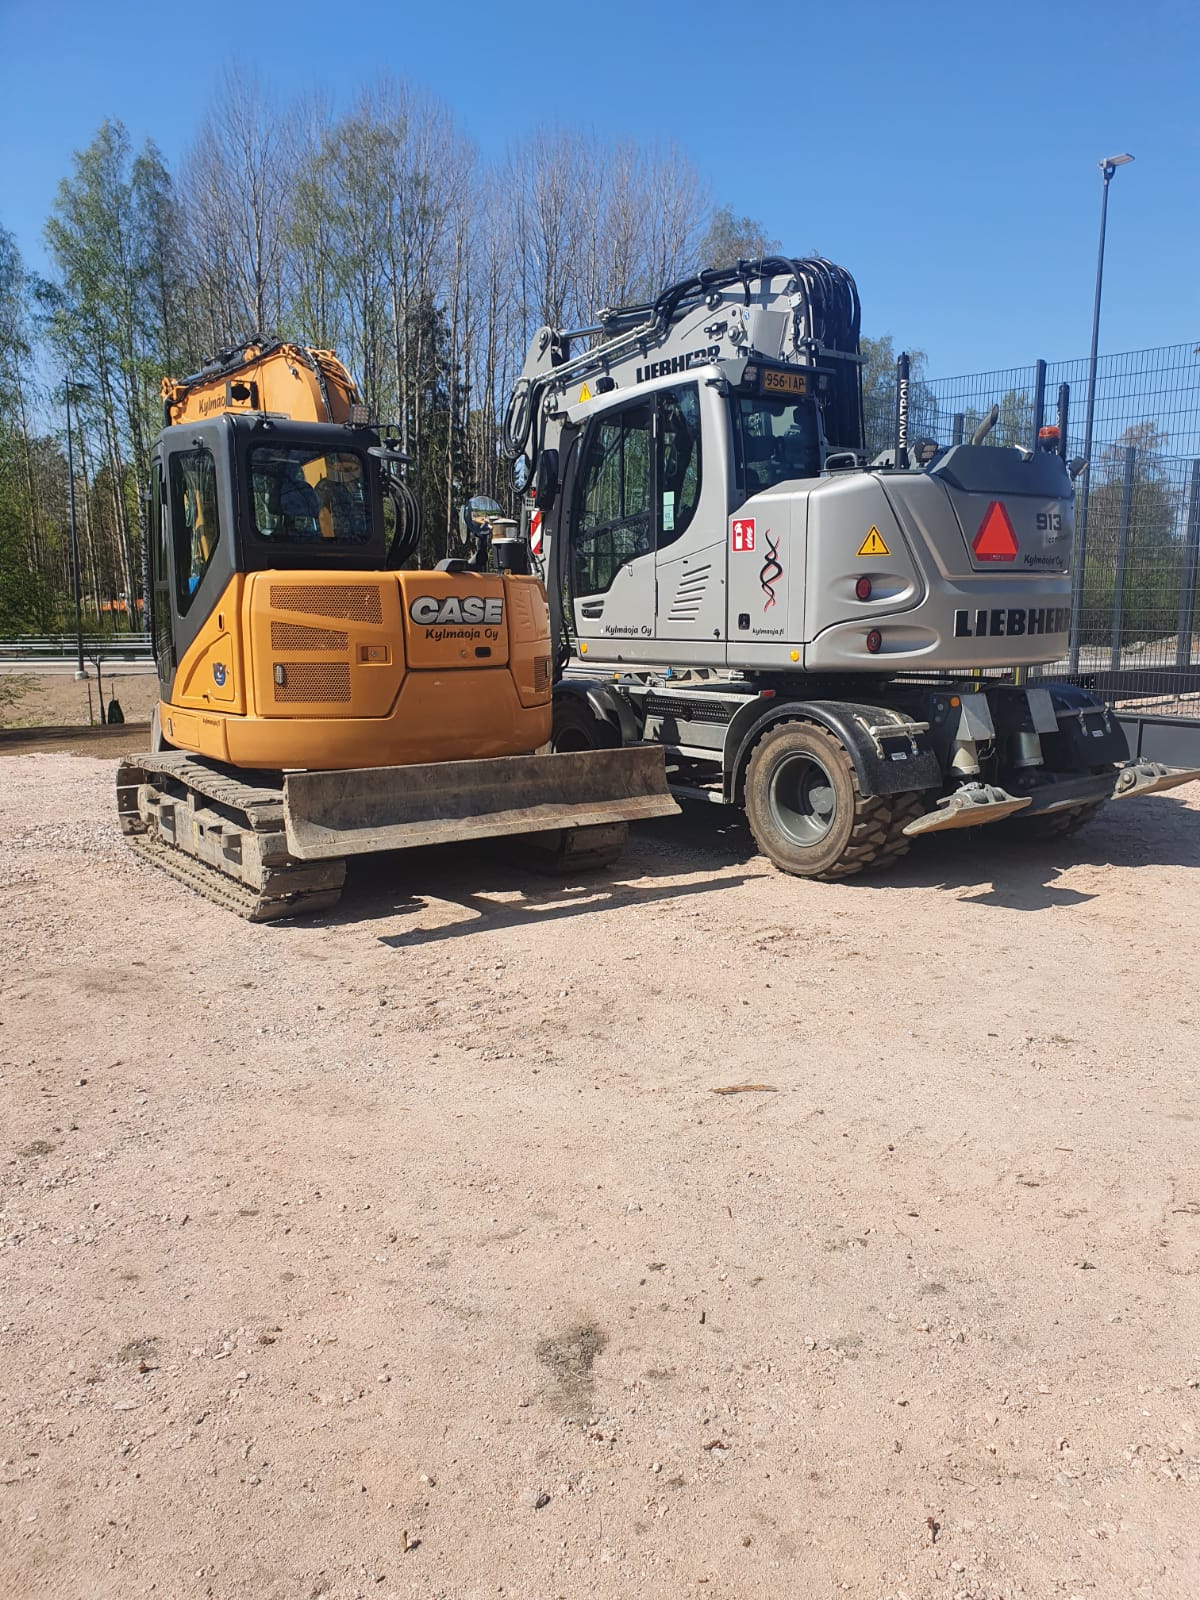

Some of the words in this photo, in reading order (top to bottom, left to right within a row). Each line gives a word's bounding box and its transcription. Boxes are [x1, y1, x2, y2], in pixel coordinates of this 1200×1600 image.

[899, 379, 909, 448] NOVATRON
[1036, 513, 1062, 530] 913
[409, 596, 504, 625] CASE
[953, 607, 1071, 637] LIEBHERR
[484, 628, 499, 640] Oy
[641, 625, 653, 637] Oy
